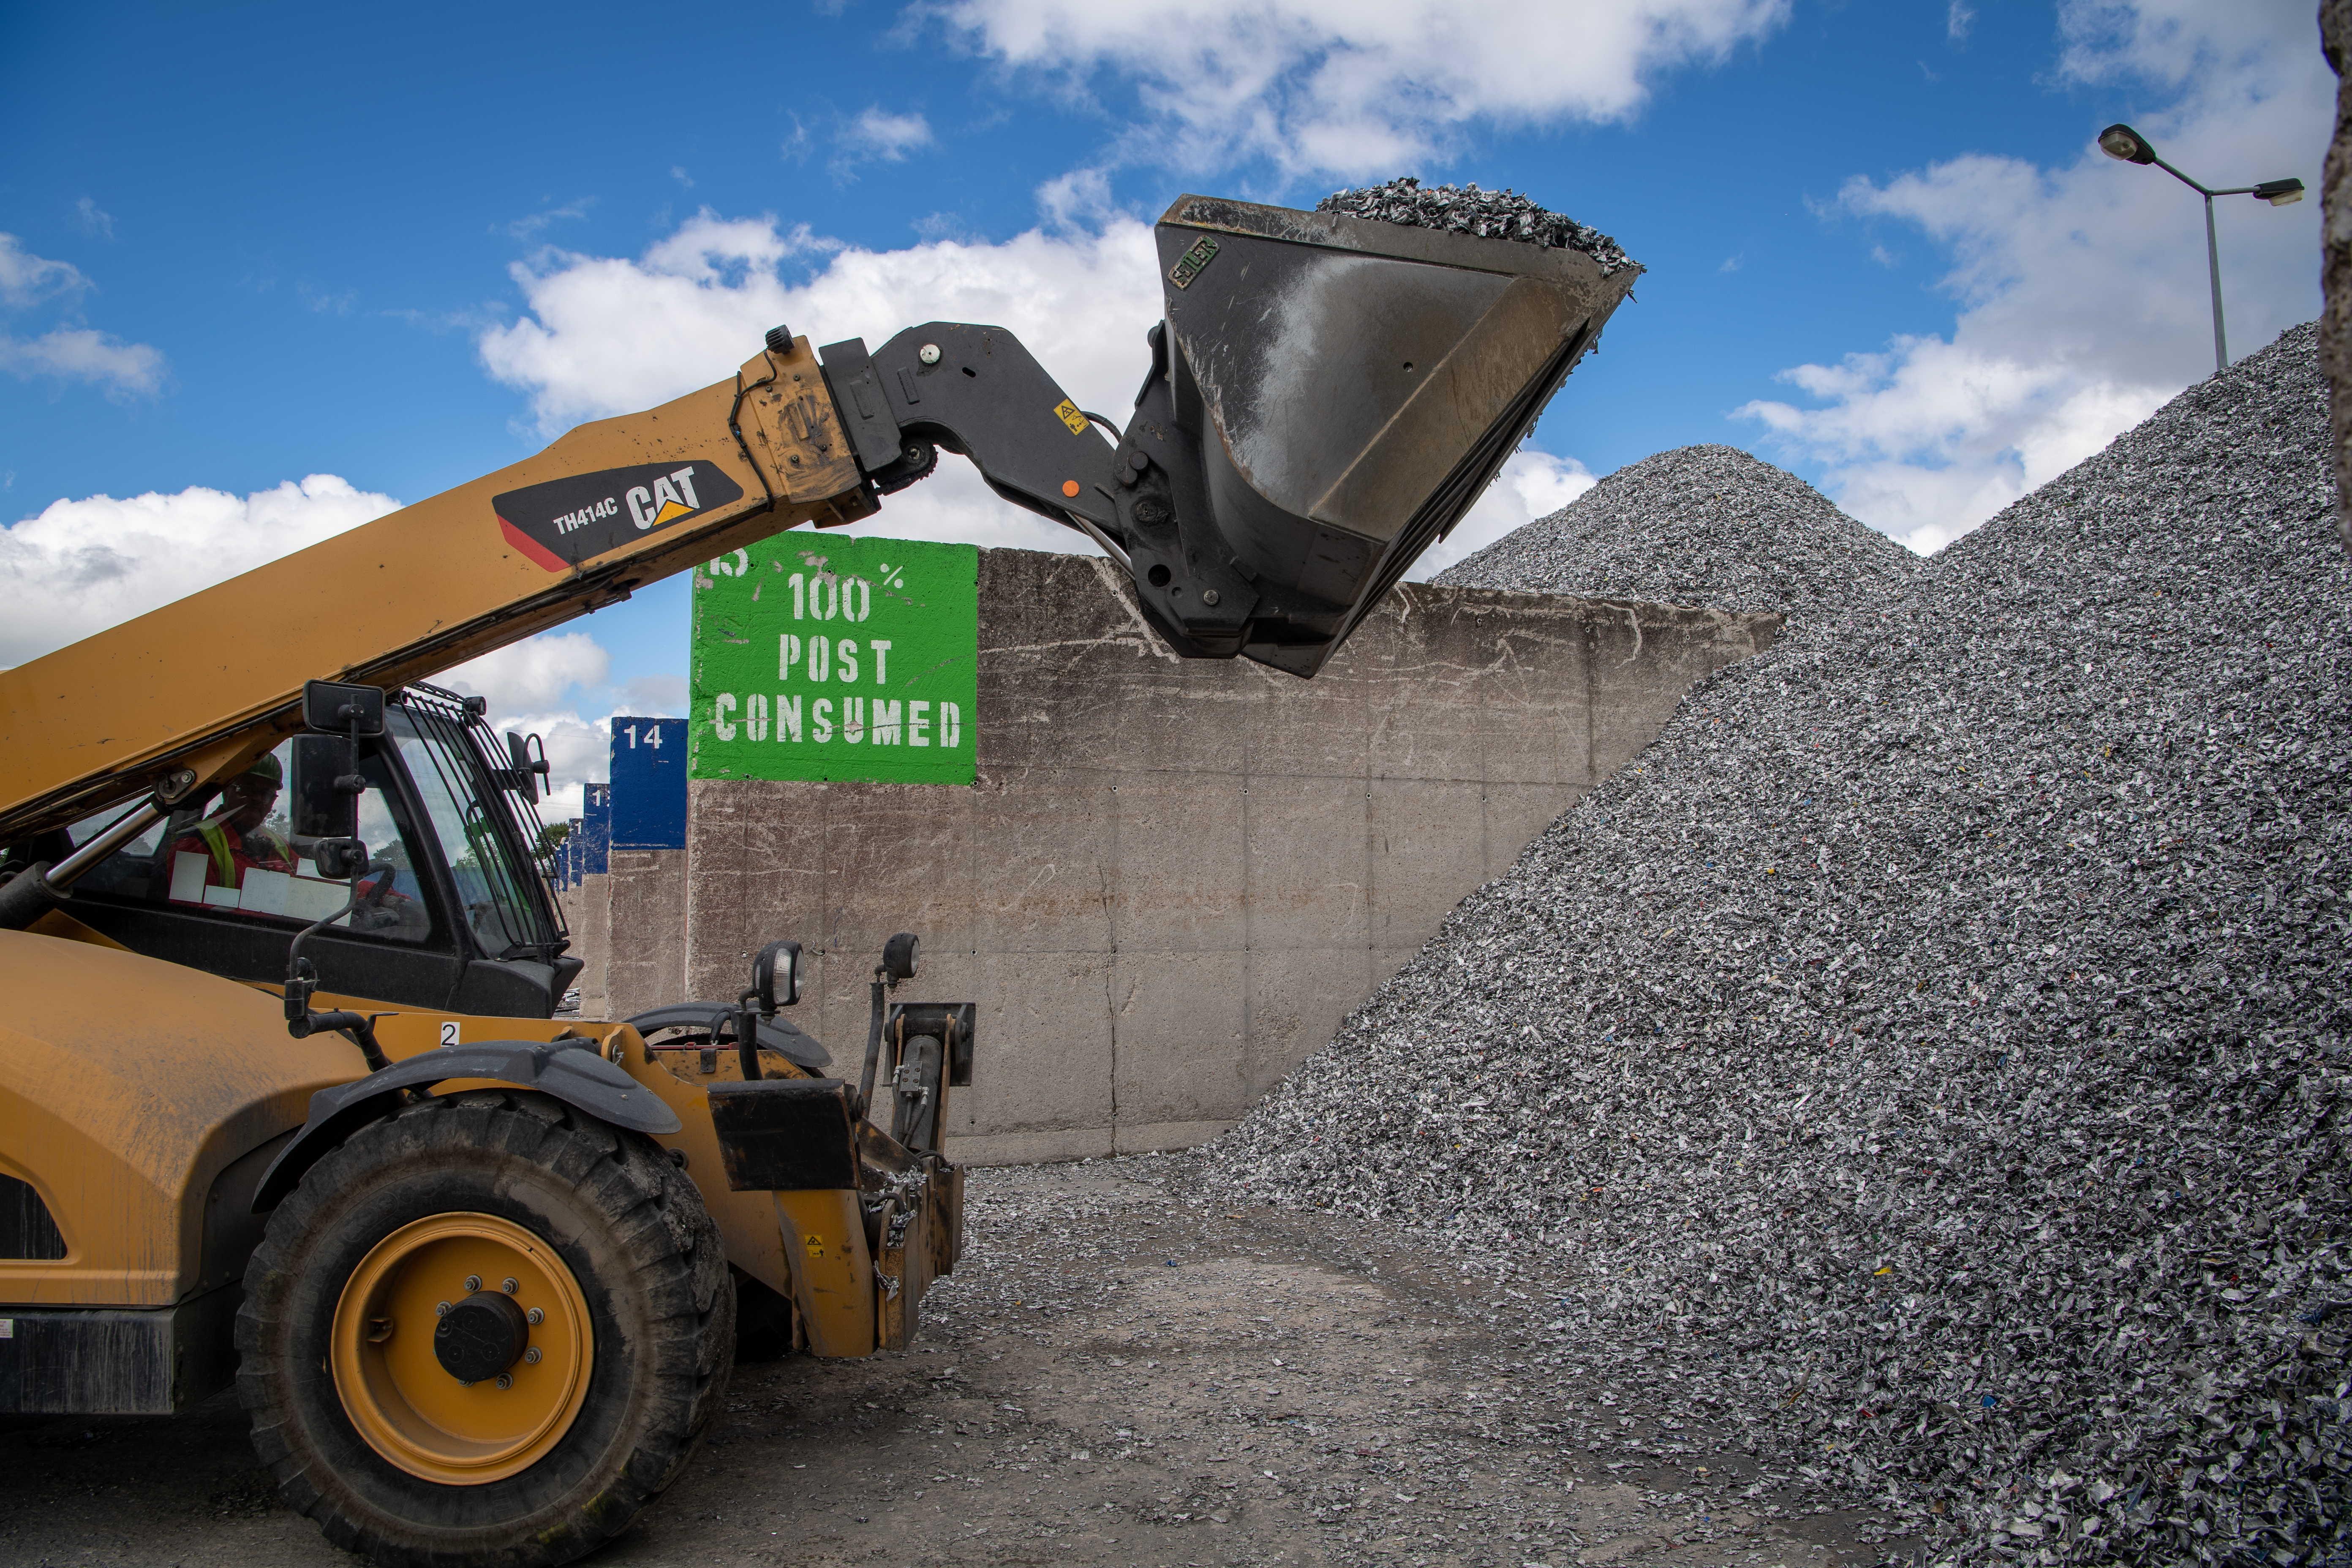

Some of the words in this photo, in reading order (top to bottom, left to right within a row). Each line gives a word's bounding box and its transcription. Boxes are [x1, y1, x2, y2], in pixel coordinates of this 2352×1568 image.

[1172, 240, 1217, 286] SEILER
[553, 497, 618, 535] TH414C
[626, 466, 700, 530] CAT
[779, 634, 892, 684] POST
[624, 725, 663, 749] 14
[715, 693, 960, 748] CONSUMED
[441, 1024, 456, 1046] 2
